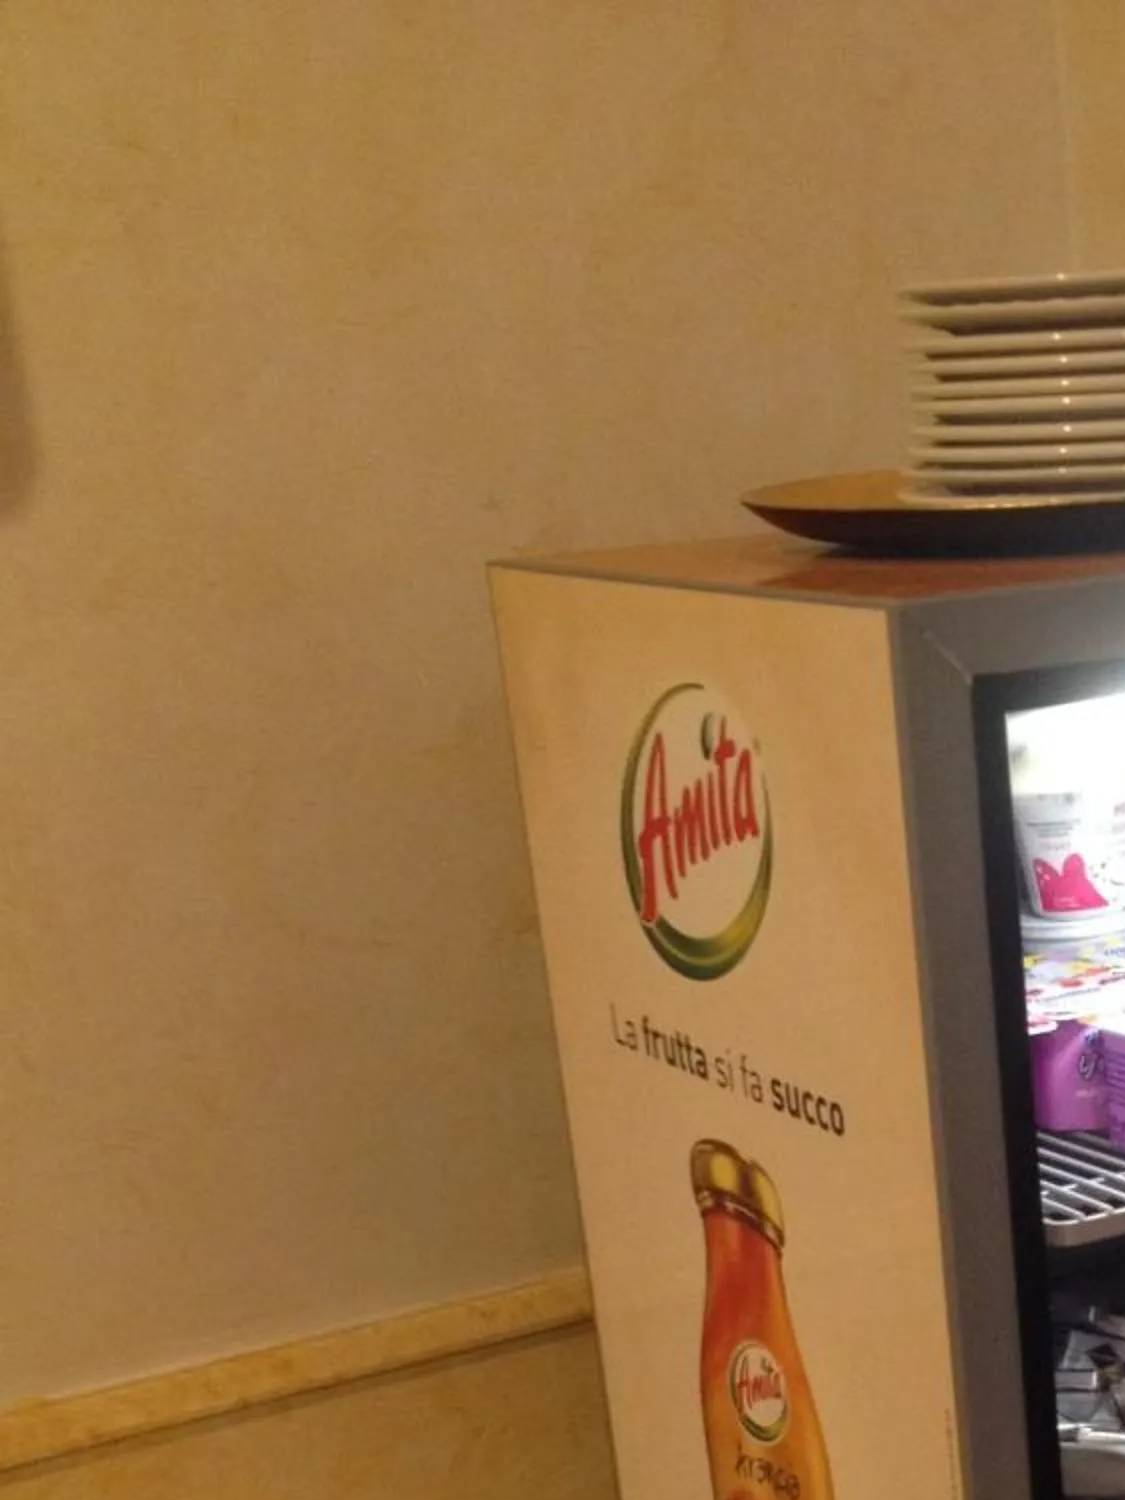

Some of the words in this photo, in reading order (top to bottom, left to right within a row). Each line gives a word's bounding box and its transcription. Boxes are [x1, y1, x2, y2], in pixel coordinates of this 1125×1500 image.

[639, 715, 760, 922] Amita
[609, 1001, 638, 1051] La
[642, 1014, 709, 1081] frutta
[714, 1048, 735, 1092] si
[740, 1054, 763, 1104] fa
[771, 1077, 846, 1137] succo
